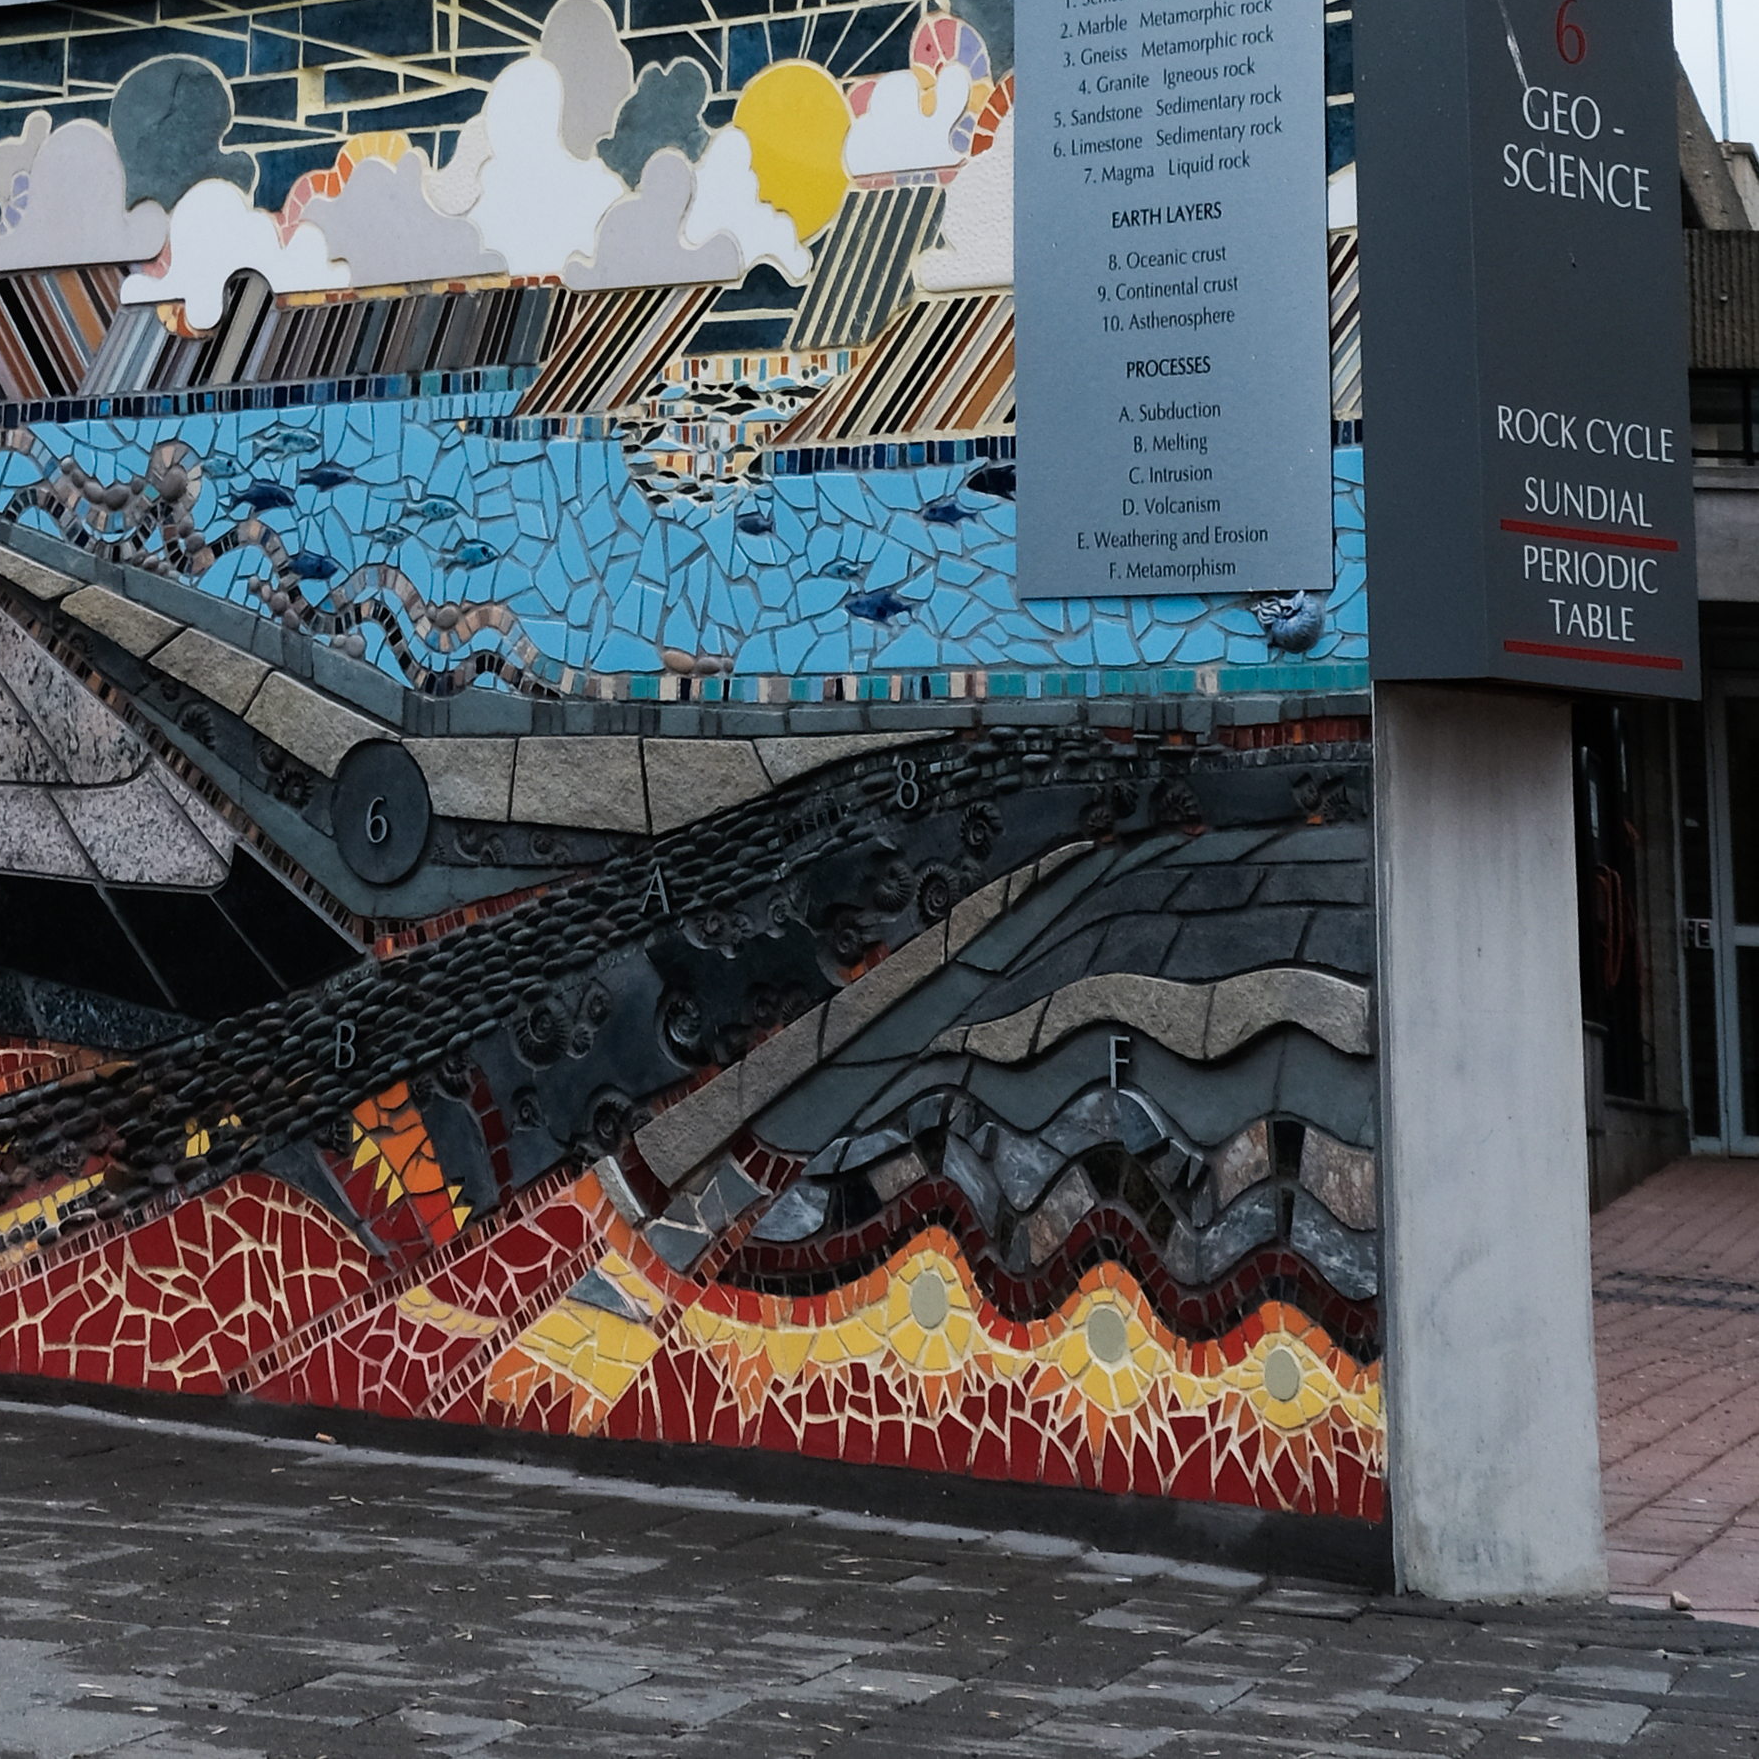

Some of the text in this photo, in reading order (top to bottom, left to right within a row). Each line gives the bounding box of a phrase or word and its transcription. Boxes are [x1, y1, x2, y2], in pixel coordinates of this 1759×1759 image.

[1061, 23, 1072, 39] 2.
[1078, 14, 1127, 36] Marble
[1140, 1, 1234, 28] Metamorphic
[1556, 0, 1586, 64] 6
[1064, 25, 1273, 67] 3. Gneiss Metamorphic rock
[1079, 56, 1255, 94] 4. Granite Igneous rock
[1054, 85, 1281, 128] 5. Sandstone Sedimentary rock
[1522, 86, 1601, 140] GEO
[1054, 116, 1282, 157] 6. Limestone Sedimentary rock
[1084, 150, 1250, 185] 7. Magma Liquid rock
[1504, 144, 1651, 211] SCIENCE
[1112, 202, 1221, 228] EARTH LAYERS
[1109, 247, 1225, 270] 8. Oceanic crust
[1098, 276, 1237, 302] 9. Continental crust
[1104, 307, 1235, 332] 10. Asthenosphere
[1127, 356, 1210, 378] PROCESSES
[1119, 401, 1220, 422] A. Subduction
[1134, 433, 1207, 454] B. Melting
[1498, 405, 1674, 462] ROCK CYCLE
[1129, 465, 1212, 484] C. Intrusion
[1123, 496, 1220, 515] D. Volcanism
[1526, 477, 1652, 527] SUNDIAL
[1078, 526, 1268, 551] E. Weathering and Erosion
[1110, 558, 1235, 582] F. Metamorphism
[1524, 545, 1657, 593] PERIODIC
[1549, 599, 1635, 641] TABLE
[895, 759, 920, 810] 8
[365, 796, 389, 844] 6
[640, 864, 670, 915] A
[334, 1021, 357, 1069] B
[1108, 1034, 1131, 1089] F
